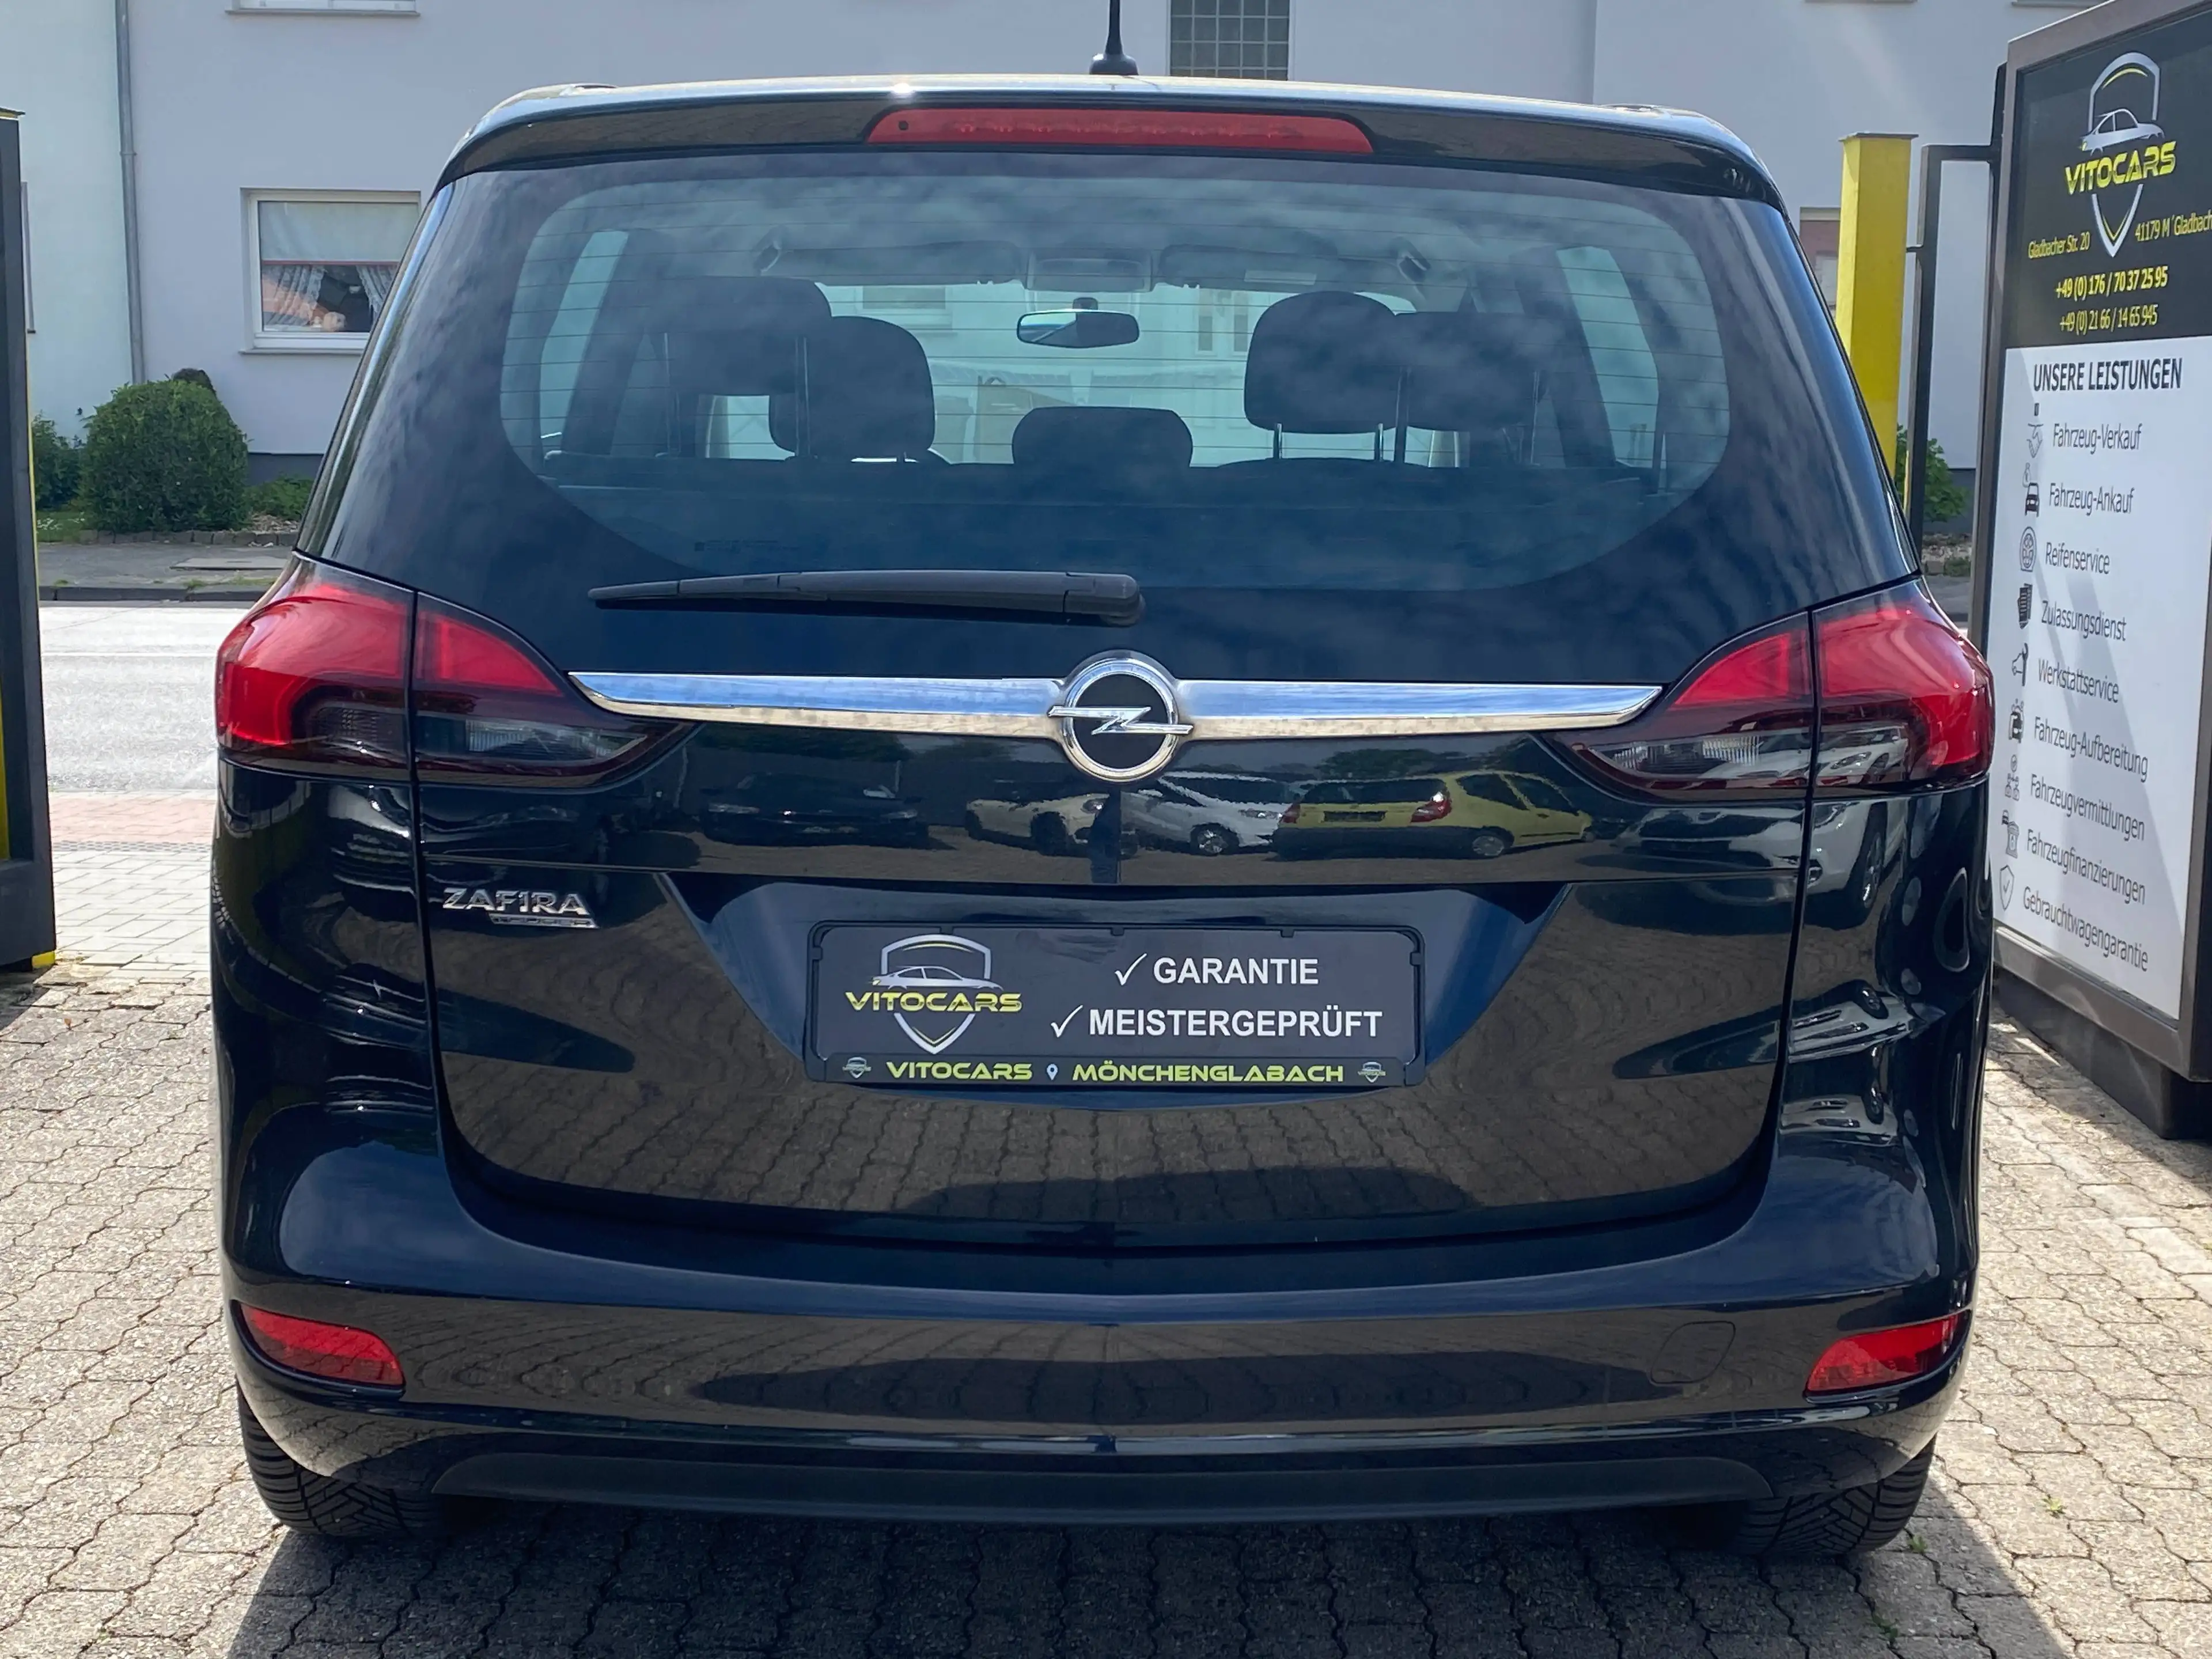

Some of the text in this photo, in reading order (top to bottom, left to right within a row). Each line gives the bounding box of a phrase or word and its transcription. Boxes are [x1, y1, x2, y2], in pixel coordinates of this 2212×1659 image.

[2065, 141, 2177, 195] VITOCARS
[2080, 231, 2090, 251] 20
[2135, 219, 2161, 241] 41179
[2056, 278, 2073, 298] +49
[2074, 275, 2088, 301] (0)
[2088, 273, 2106, 295] 176
[2113, 270, 2126, 293] 70
[2127, 269, 2140, 291] 37
[2141, 267, 2154, 289] 25
[2155, 265, 2168, 287] 95
[2060, 311, 2075, 332] +49
[2076, 309, 2088, 335] (0)
[2118, 306, 2128, 328] 14
[2130, 305, 2141, 327] 65
[2033, 357, 2183, 391] UNSERE LEISTUNGEN
[2052, 423, 2143, 454] Fahrzeug-Verkauf
[2048, 482, 2135, 516] Fahrzeug-Ankauf
[2045, 541, 2110, 574] Reifenservice
[2041, 600, 2127, 642] Zulassungsdienst
[2038, 658, 2119, 703] Werkstattservice
[2034, 716, 2149, 783] Fahrzeug-Aufbereitung
[2030, 773, 2145, 842] Fahrzeugvermittlungen
[2027, 830, 2146, 905] Fahrzeugfinanzierungen
[443, 888, 590, 915] ZAFIRA
[2023, 886, 2149, 972] Gebrauchtwagengarantie
[1153, 957, 1319, 984] GARANTIE
[845, 991, 1023, 1012] VITOCARS
[1089, 1005, 1383, 1037] MEISTERGEPRÜFT
[886, 1060, 1344, 1082] VITOCARS MÖNCHENGLABACH
